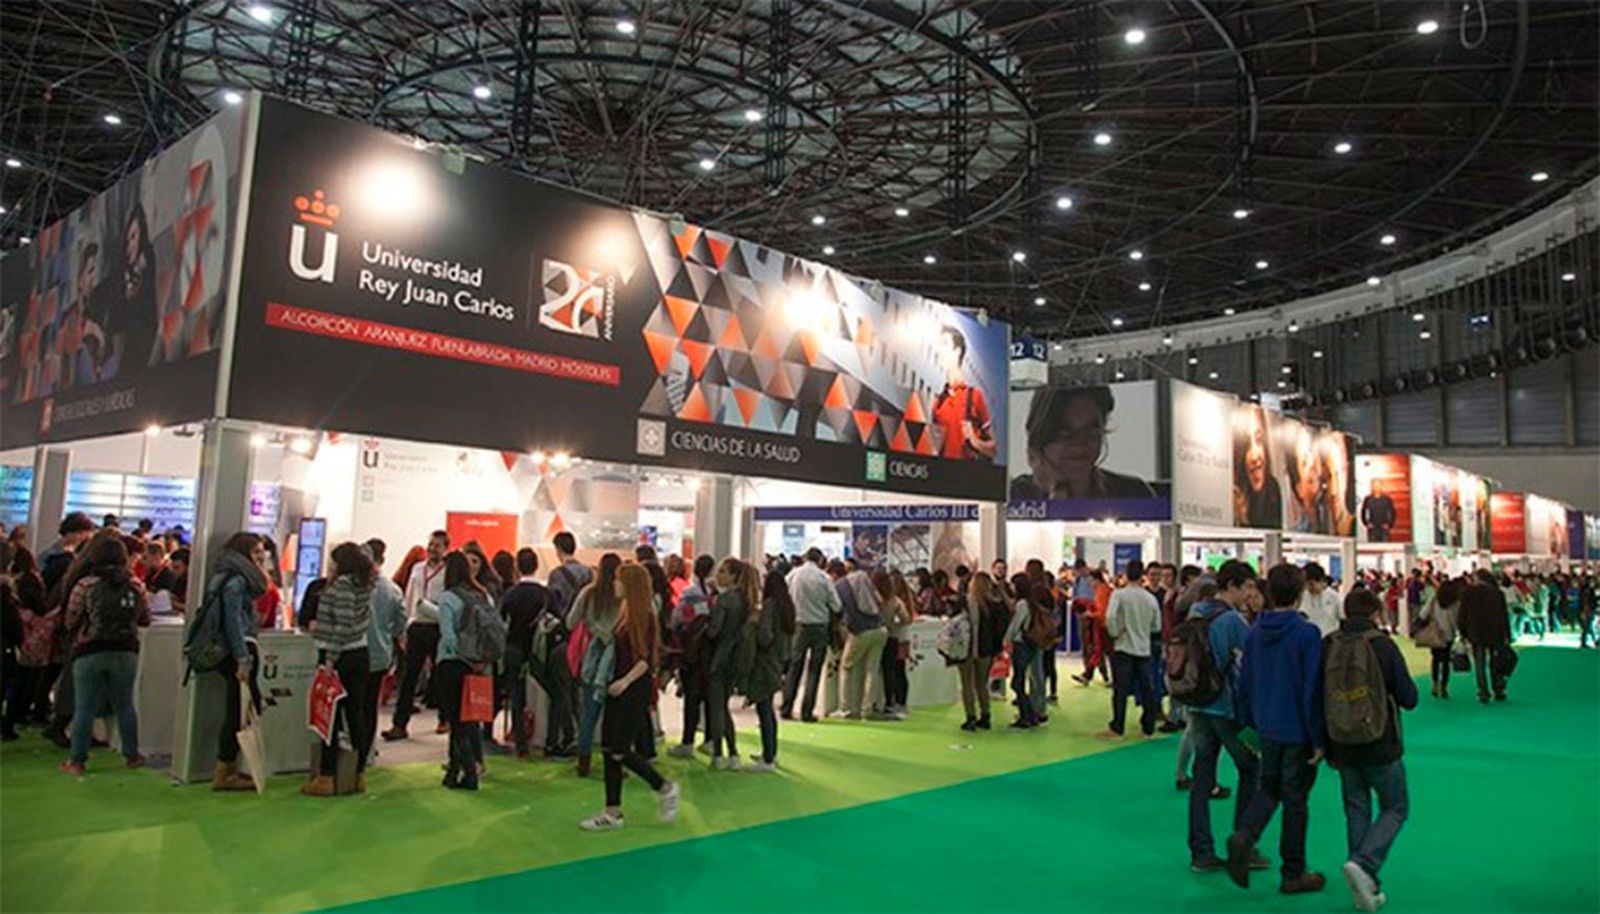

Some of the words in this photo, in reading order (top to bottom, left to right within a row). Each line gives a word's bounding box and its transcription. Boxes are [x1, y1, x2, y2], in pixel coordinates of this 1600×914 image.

[362, 240, 483, 287] Universidad
[359, 270, 399, 301] Rey
[402, 279, 448, 305] Juan
[454, 290, 515, 320] Carlos
[281, 310, 359, 335] ALCORCÓN
[363, 325, 428, 349] ARANJUEZ
[515, 352, 558, 371] MADRID
[671, 430, 728, 455] CIENCIAS
[729, 438, 745, 457] DE
[747, 441, 761, 459] LA
[763, 442, 801, 463] SALUD
[888, 459, 929, 479] CIENCIAS
[831, 504, 902, 518] Universidad
[905, 504, 948, 518] Carlos
[951, 504, 968, 518] III
[1007, 502, 1046, 518] adrid
